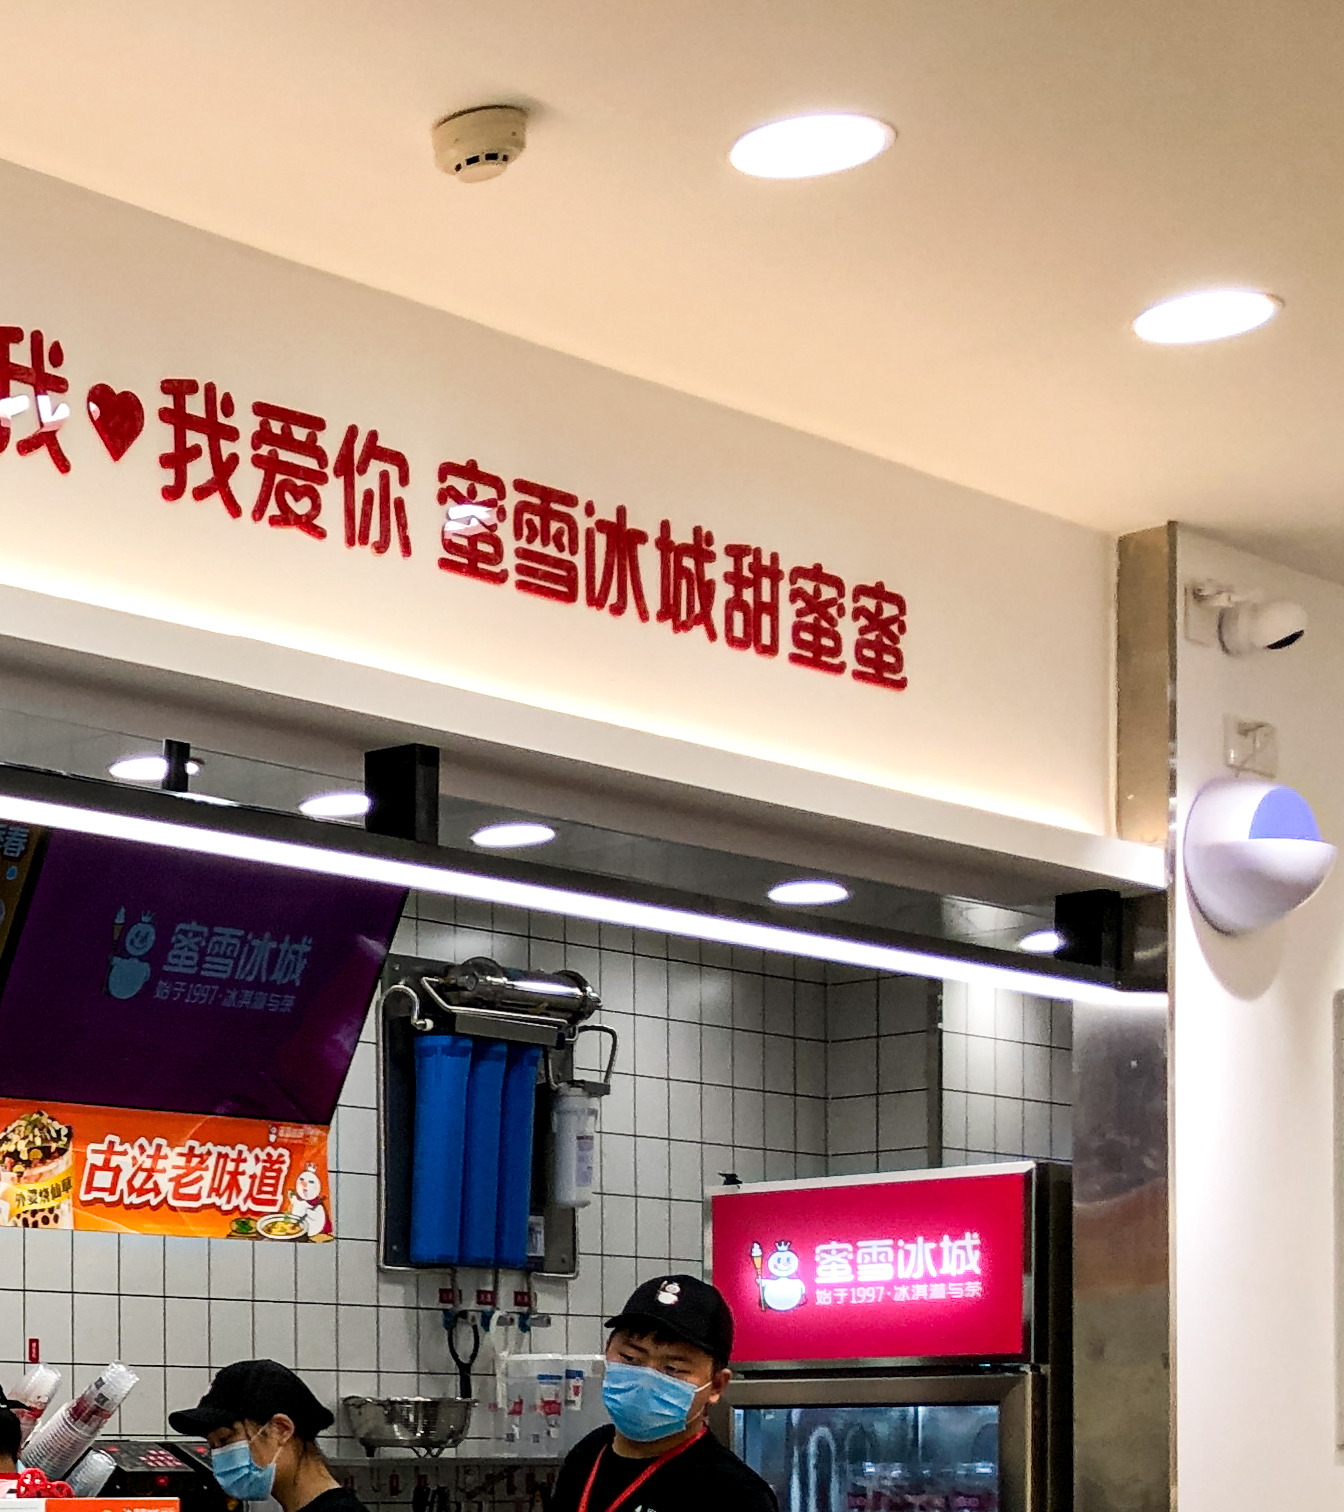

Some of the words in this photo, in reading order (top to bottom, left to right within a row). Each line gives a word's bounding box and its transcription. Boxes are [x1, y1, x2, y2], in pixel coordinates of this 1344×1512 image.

[157, 377, 414, 559] 我爱你
[436, 459, 910, 694] 蜜雪冰城甜蜜蜜
[162, 921, 312, 987] 蜜雪冰城
[83, 1139, 288, 1212] 古法老味道
[815, 1231, 981, 1284] 蜜雪冰城
[815, 1281, 983, 1306] 始于1997·冰淇淋与茶
